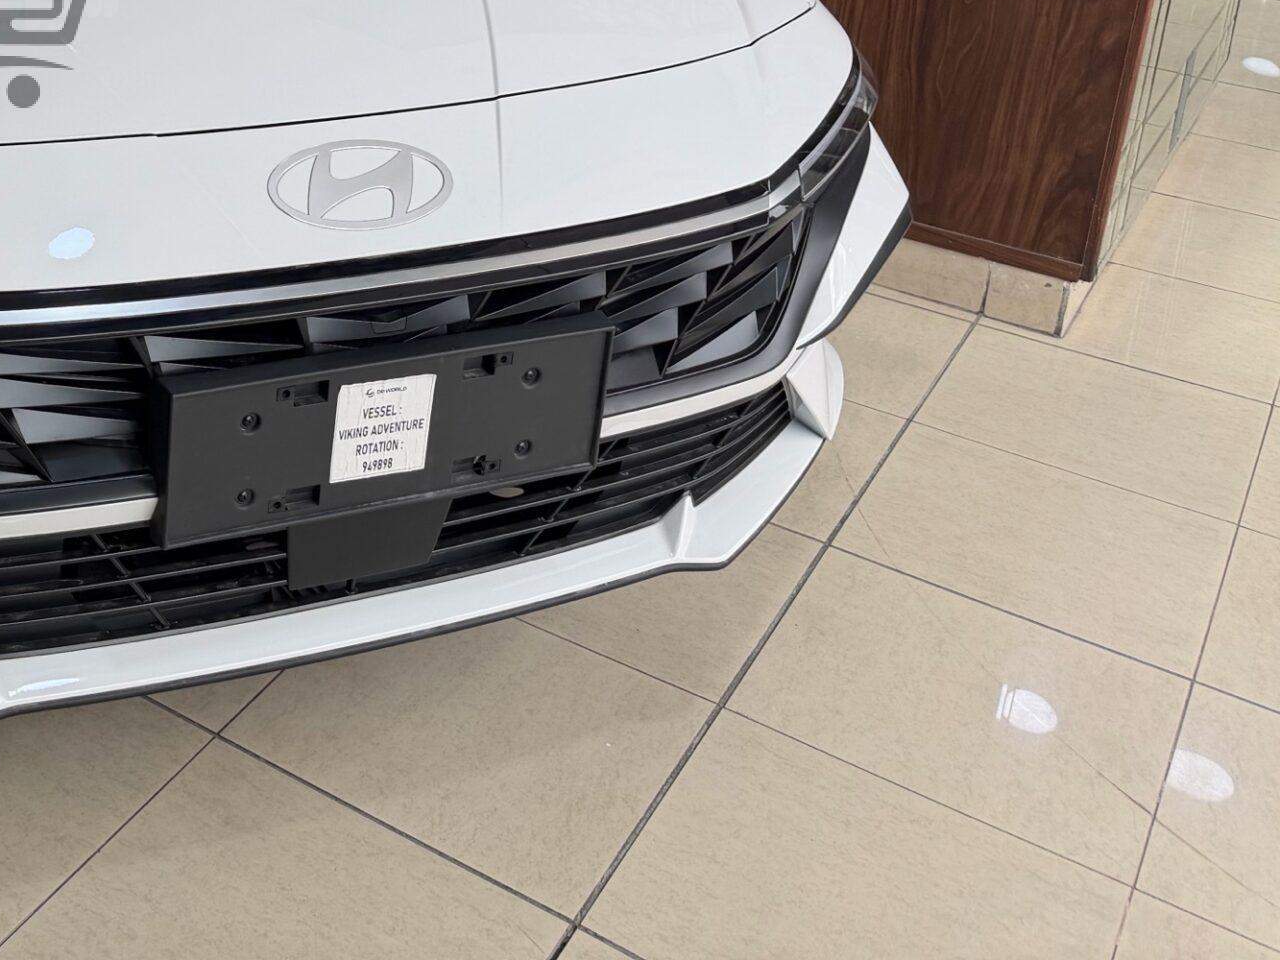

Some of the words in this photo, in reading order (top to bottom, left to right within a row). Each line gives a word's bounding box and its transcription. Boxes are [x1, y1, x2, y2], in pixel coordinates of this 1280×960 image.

[362, 405, 397, 419] VESSEL
[338, 426, 368, 440] VIKING
[371, 418, 425, 435] ADVENTURE
[355, 439, 399, 456] ROTATION
[362, 457, 393, 472] 949898
